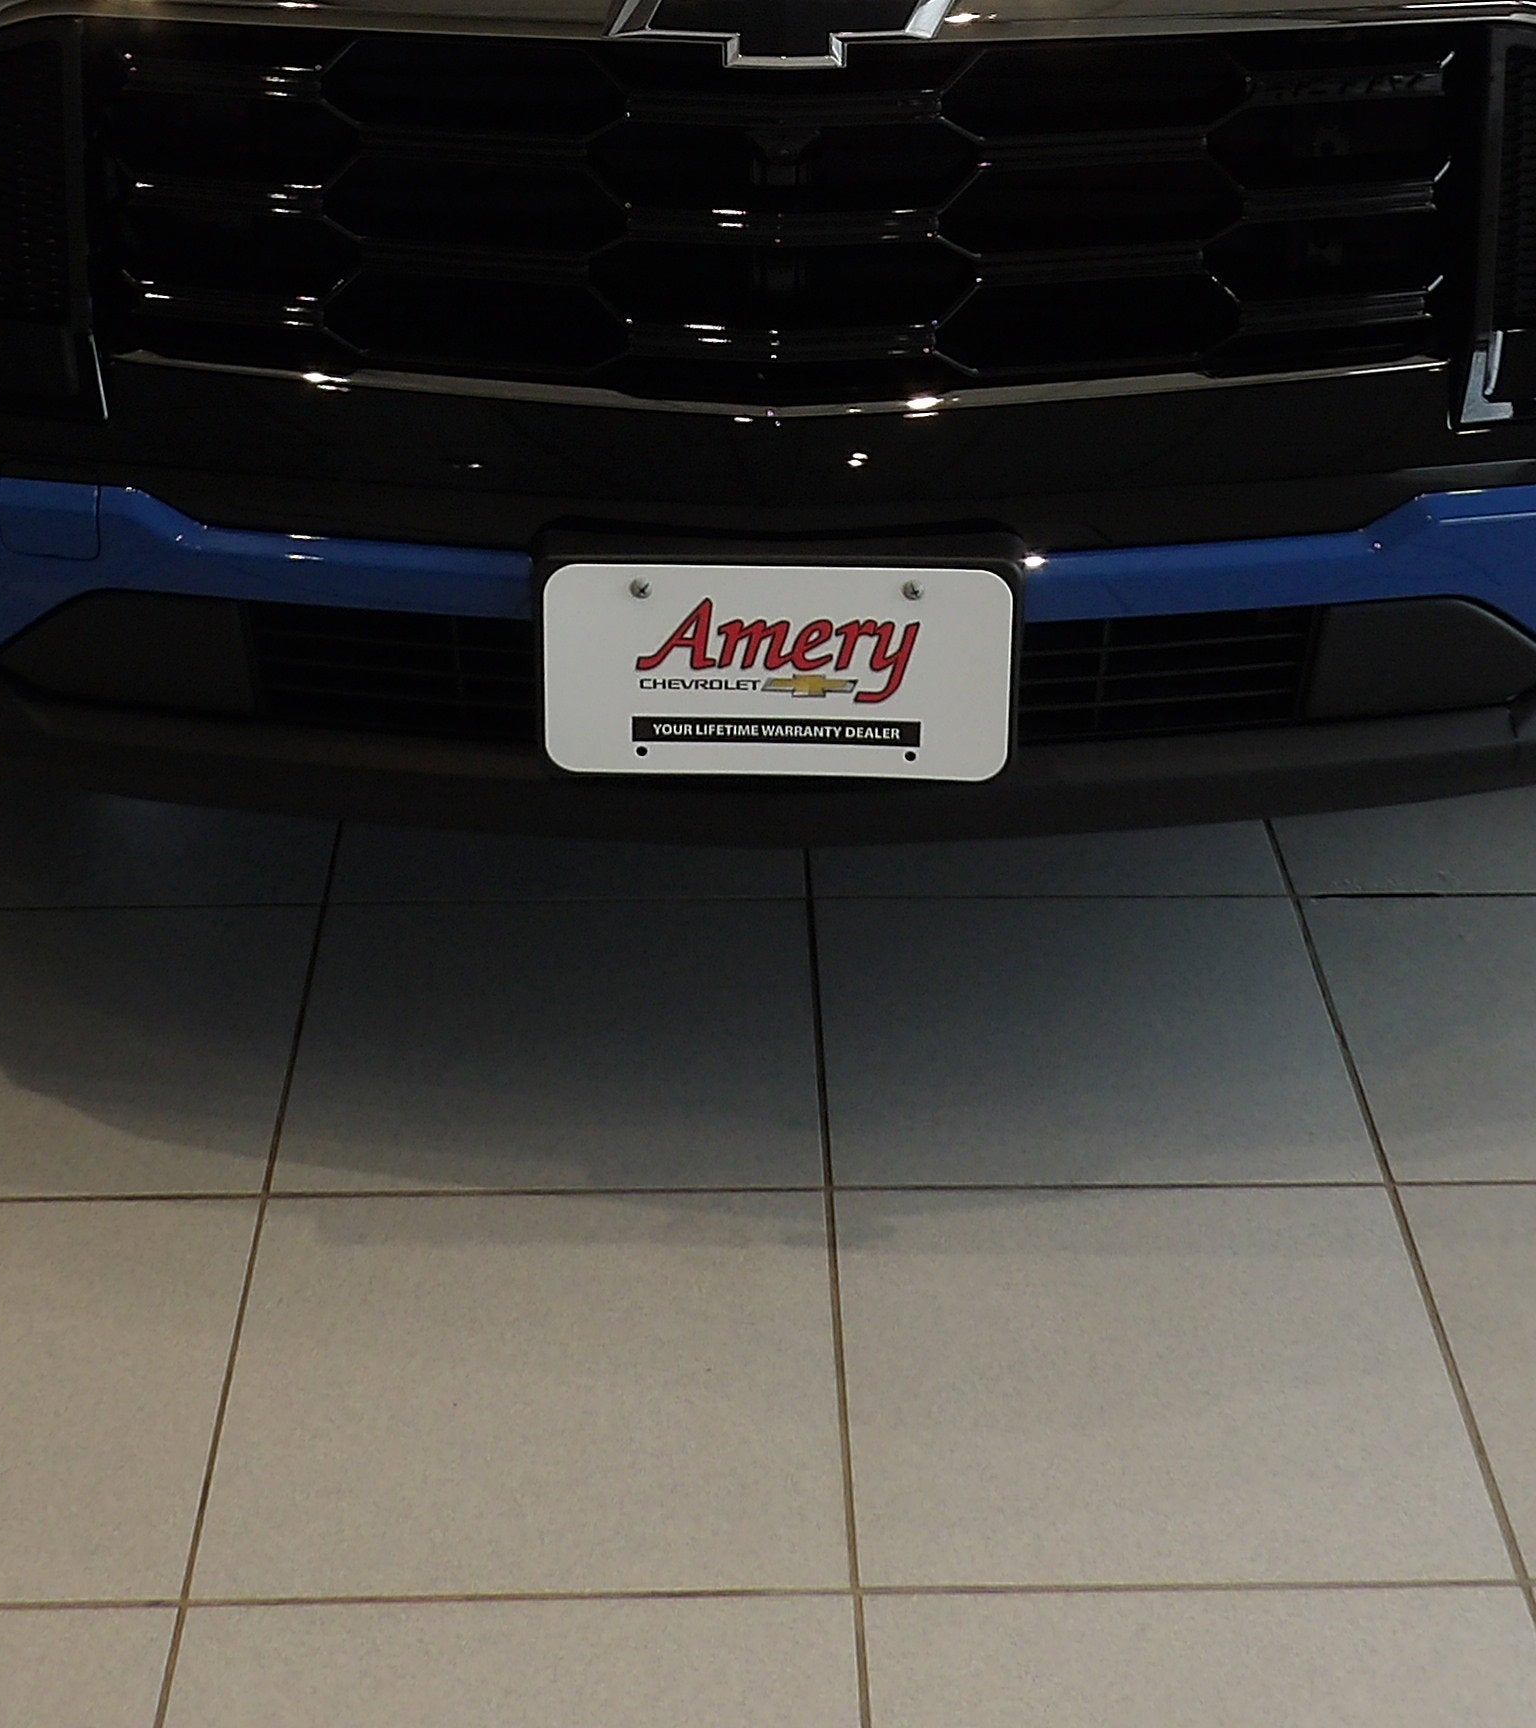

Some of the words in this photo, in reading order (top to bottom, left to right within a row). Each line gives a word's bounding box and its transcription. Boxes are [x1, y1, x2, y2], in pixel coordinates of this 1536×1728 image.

[635, 597, 920, 704] Amery
[639, 678, 761, 691] CHEVROLET
[653, 723, 693, 736] YOUR
[695, 724, 759, 737] LIFETIME
[761, 725, 842, 739] WARRANTY
[845, 726, 900, 740] DEALER
